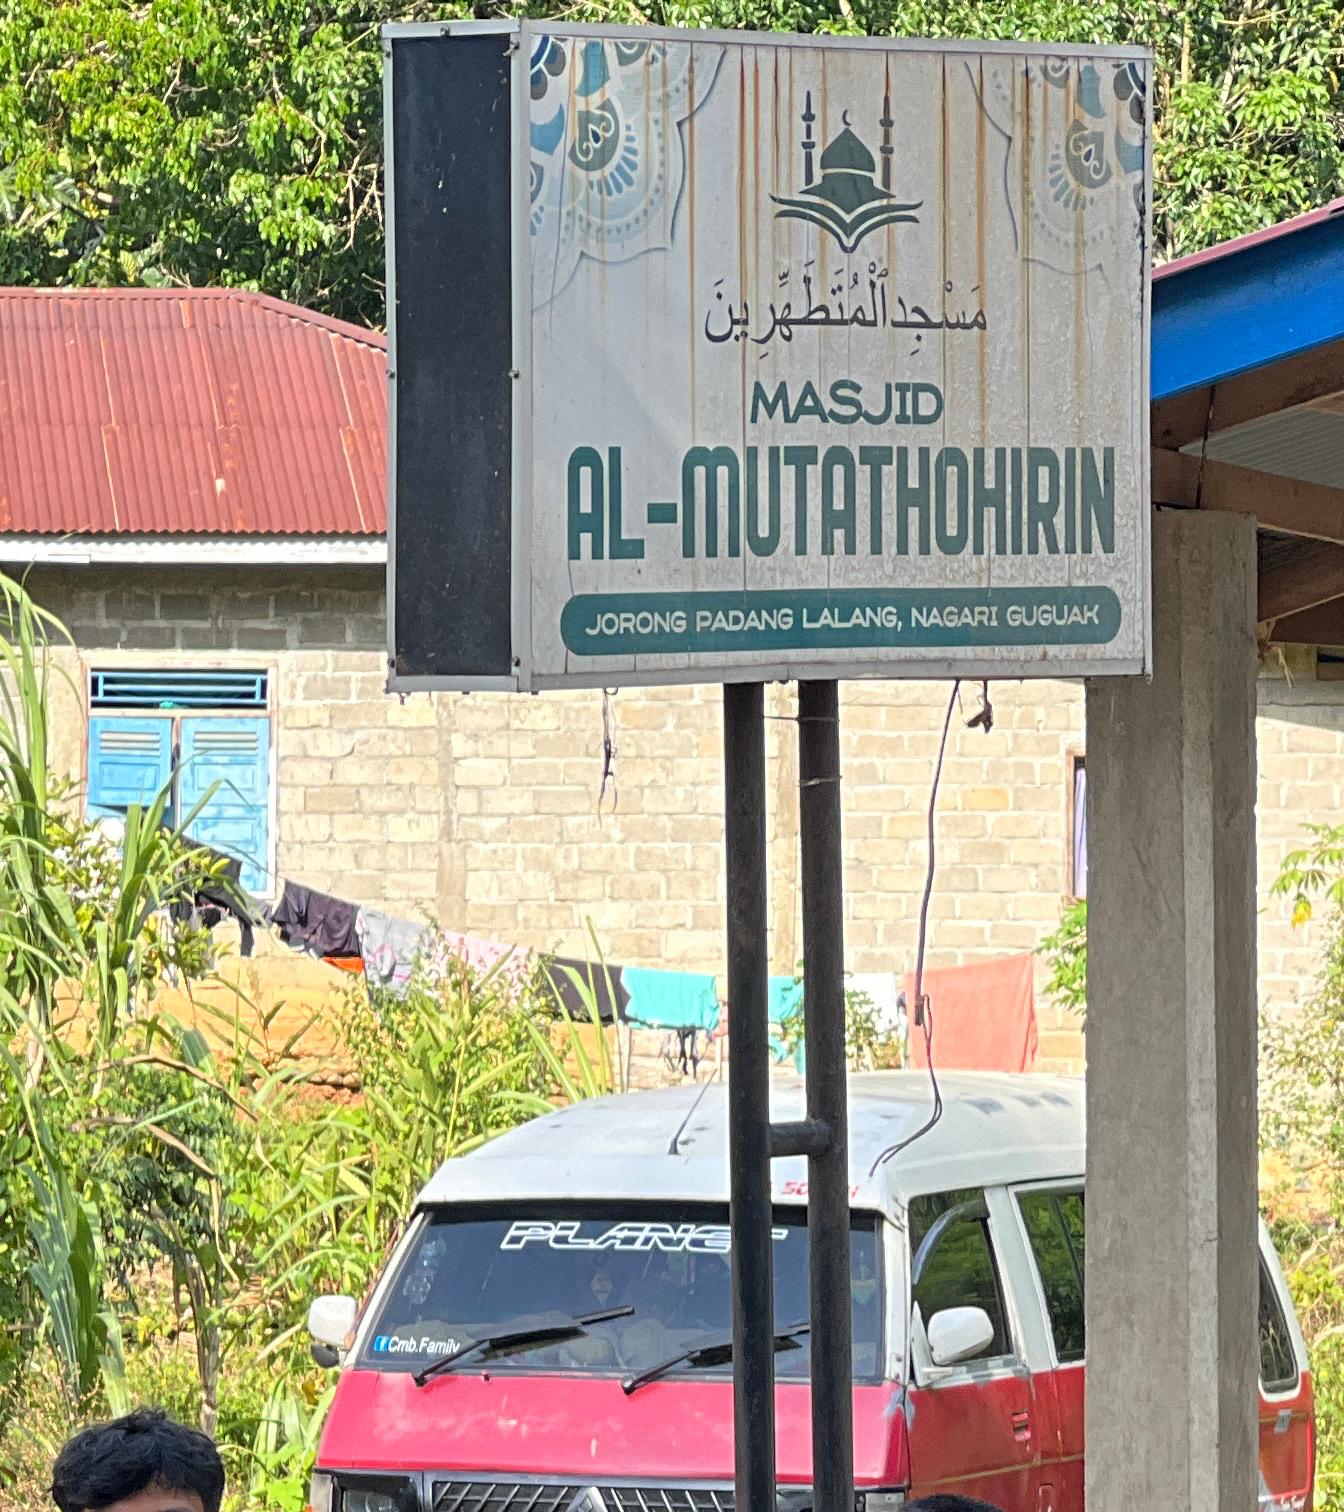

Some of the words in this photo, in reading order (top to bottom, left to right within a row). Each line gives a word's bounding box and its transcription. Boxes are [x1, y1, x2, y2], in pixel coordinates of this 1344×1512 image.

[750, 379, 945, 425] MASJID
[567, 445, 1115, 560] AL-MUTATHOHIRIN
[585, 610, 687, 636] JORONG
[696, 608, 794, 632] PADANG
[802, 605, 903, 632] LALANG,
[911, 605, 998, 627] NAGARI
[1006, 604, 1099, 626] GUGUAK
